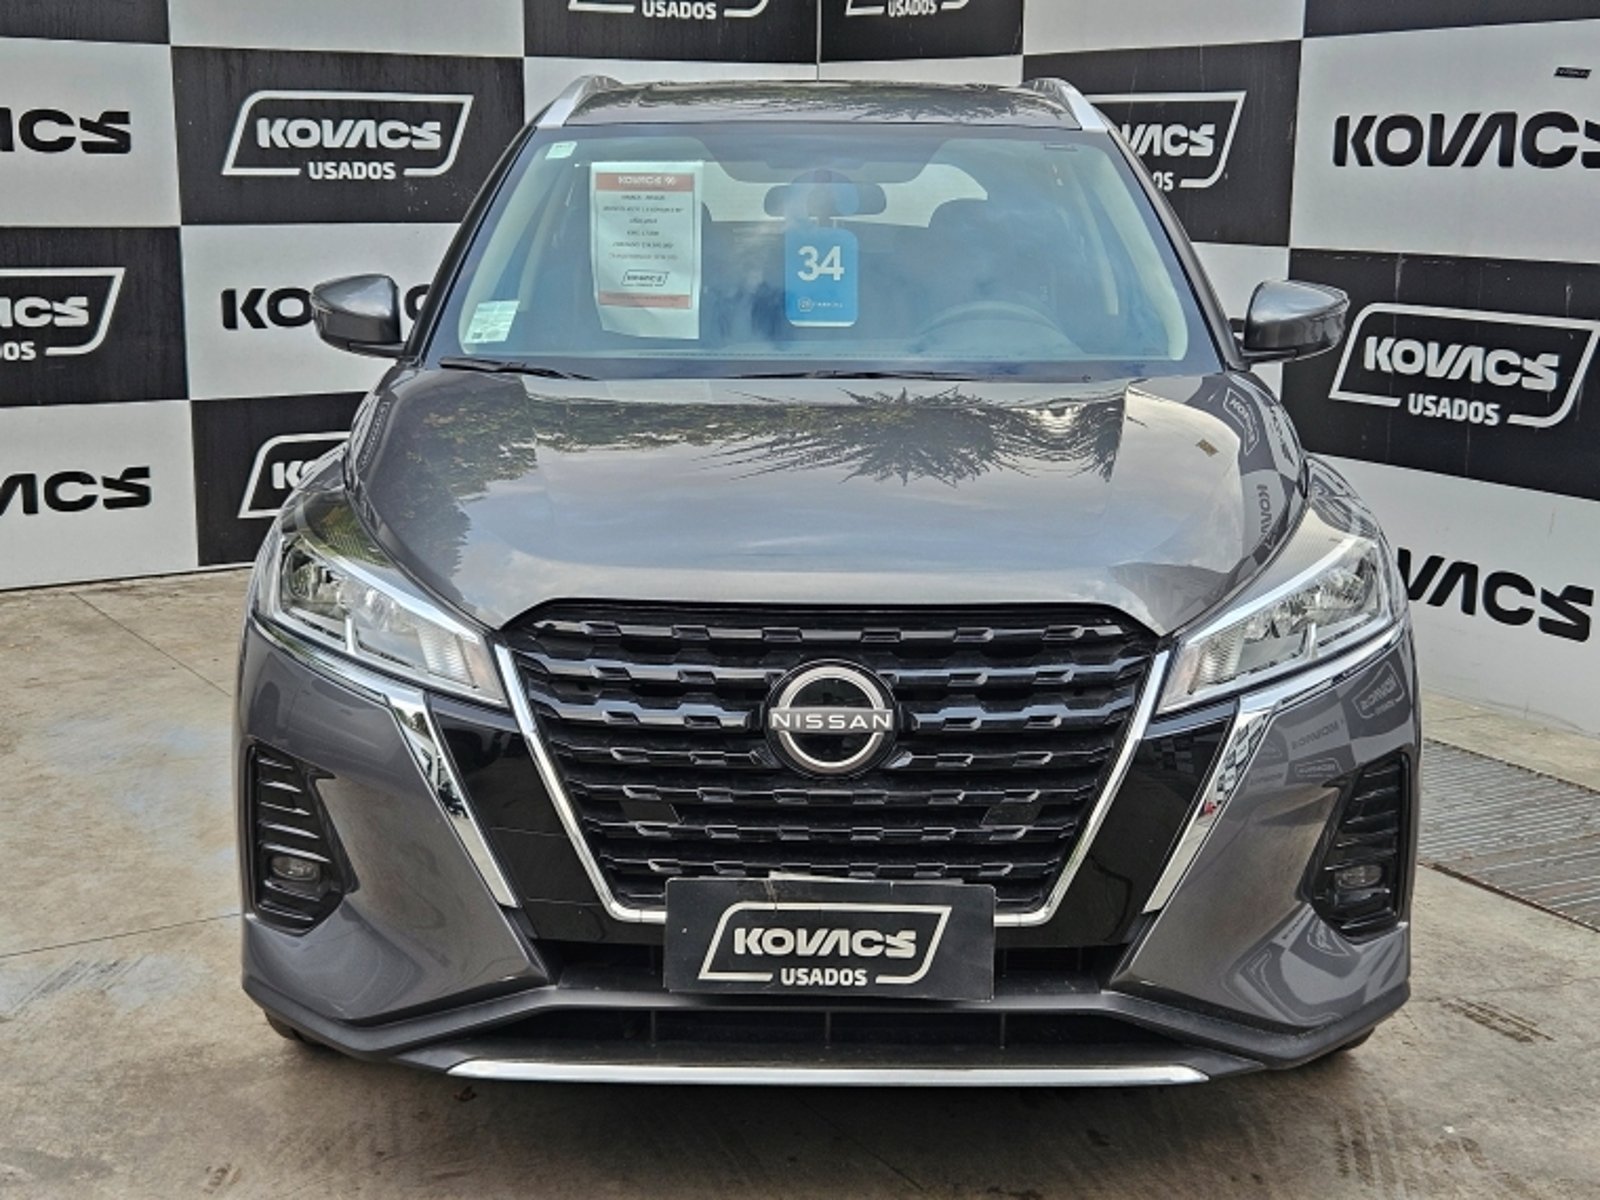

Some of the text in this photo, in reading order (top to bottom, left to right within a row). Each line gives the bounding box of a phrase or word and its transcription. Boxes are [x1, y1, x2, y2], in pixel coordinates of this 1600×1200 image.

[642, 0, 716, 19] USADOS
[888, 0, 937, 17] USADOS
[256, 117, 441, 150] KOVACS
[1121, 123, 1215, 157] VACS
[308, 161, 396, 180] USADOS
[797, 245, 845, 282] 34
[1364, 335, 1560, 391] KOVACS
[1407, 393, 1500, 426] USADOS
[1397, 547, 1594, 643] VACS
[772, 713, 892, 730] NISSAN
[733, 927, 917, 958] KOVACS
[780, 968, 867, 987] USADOS
